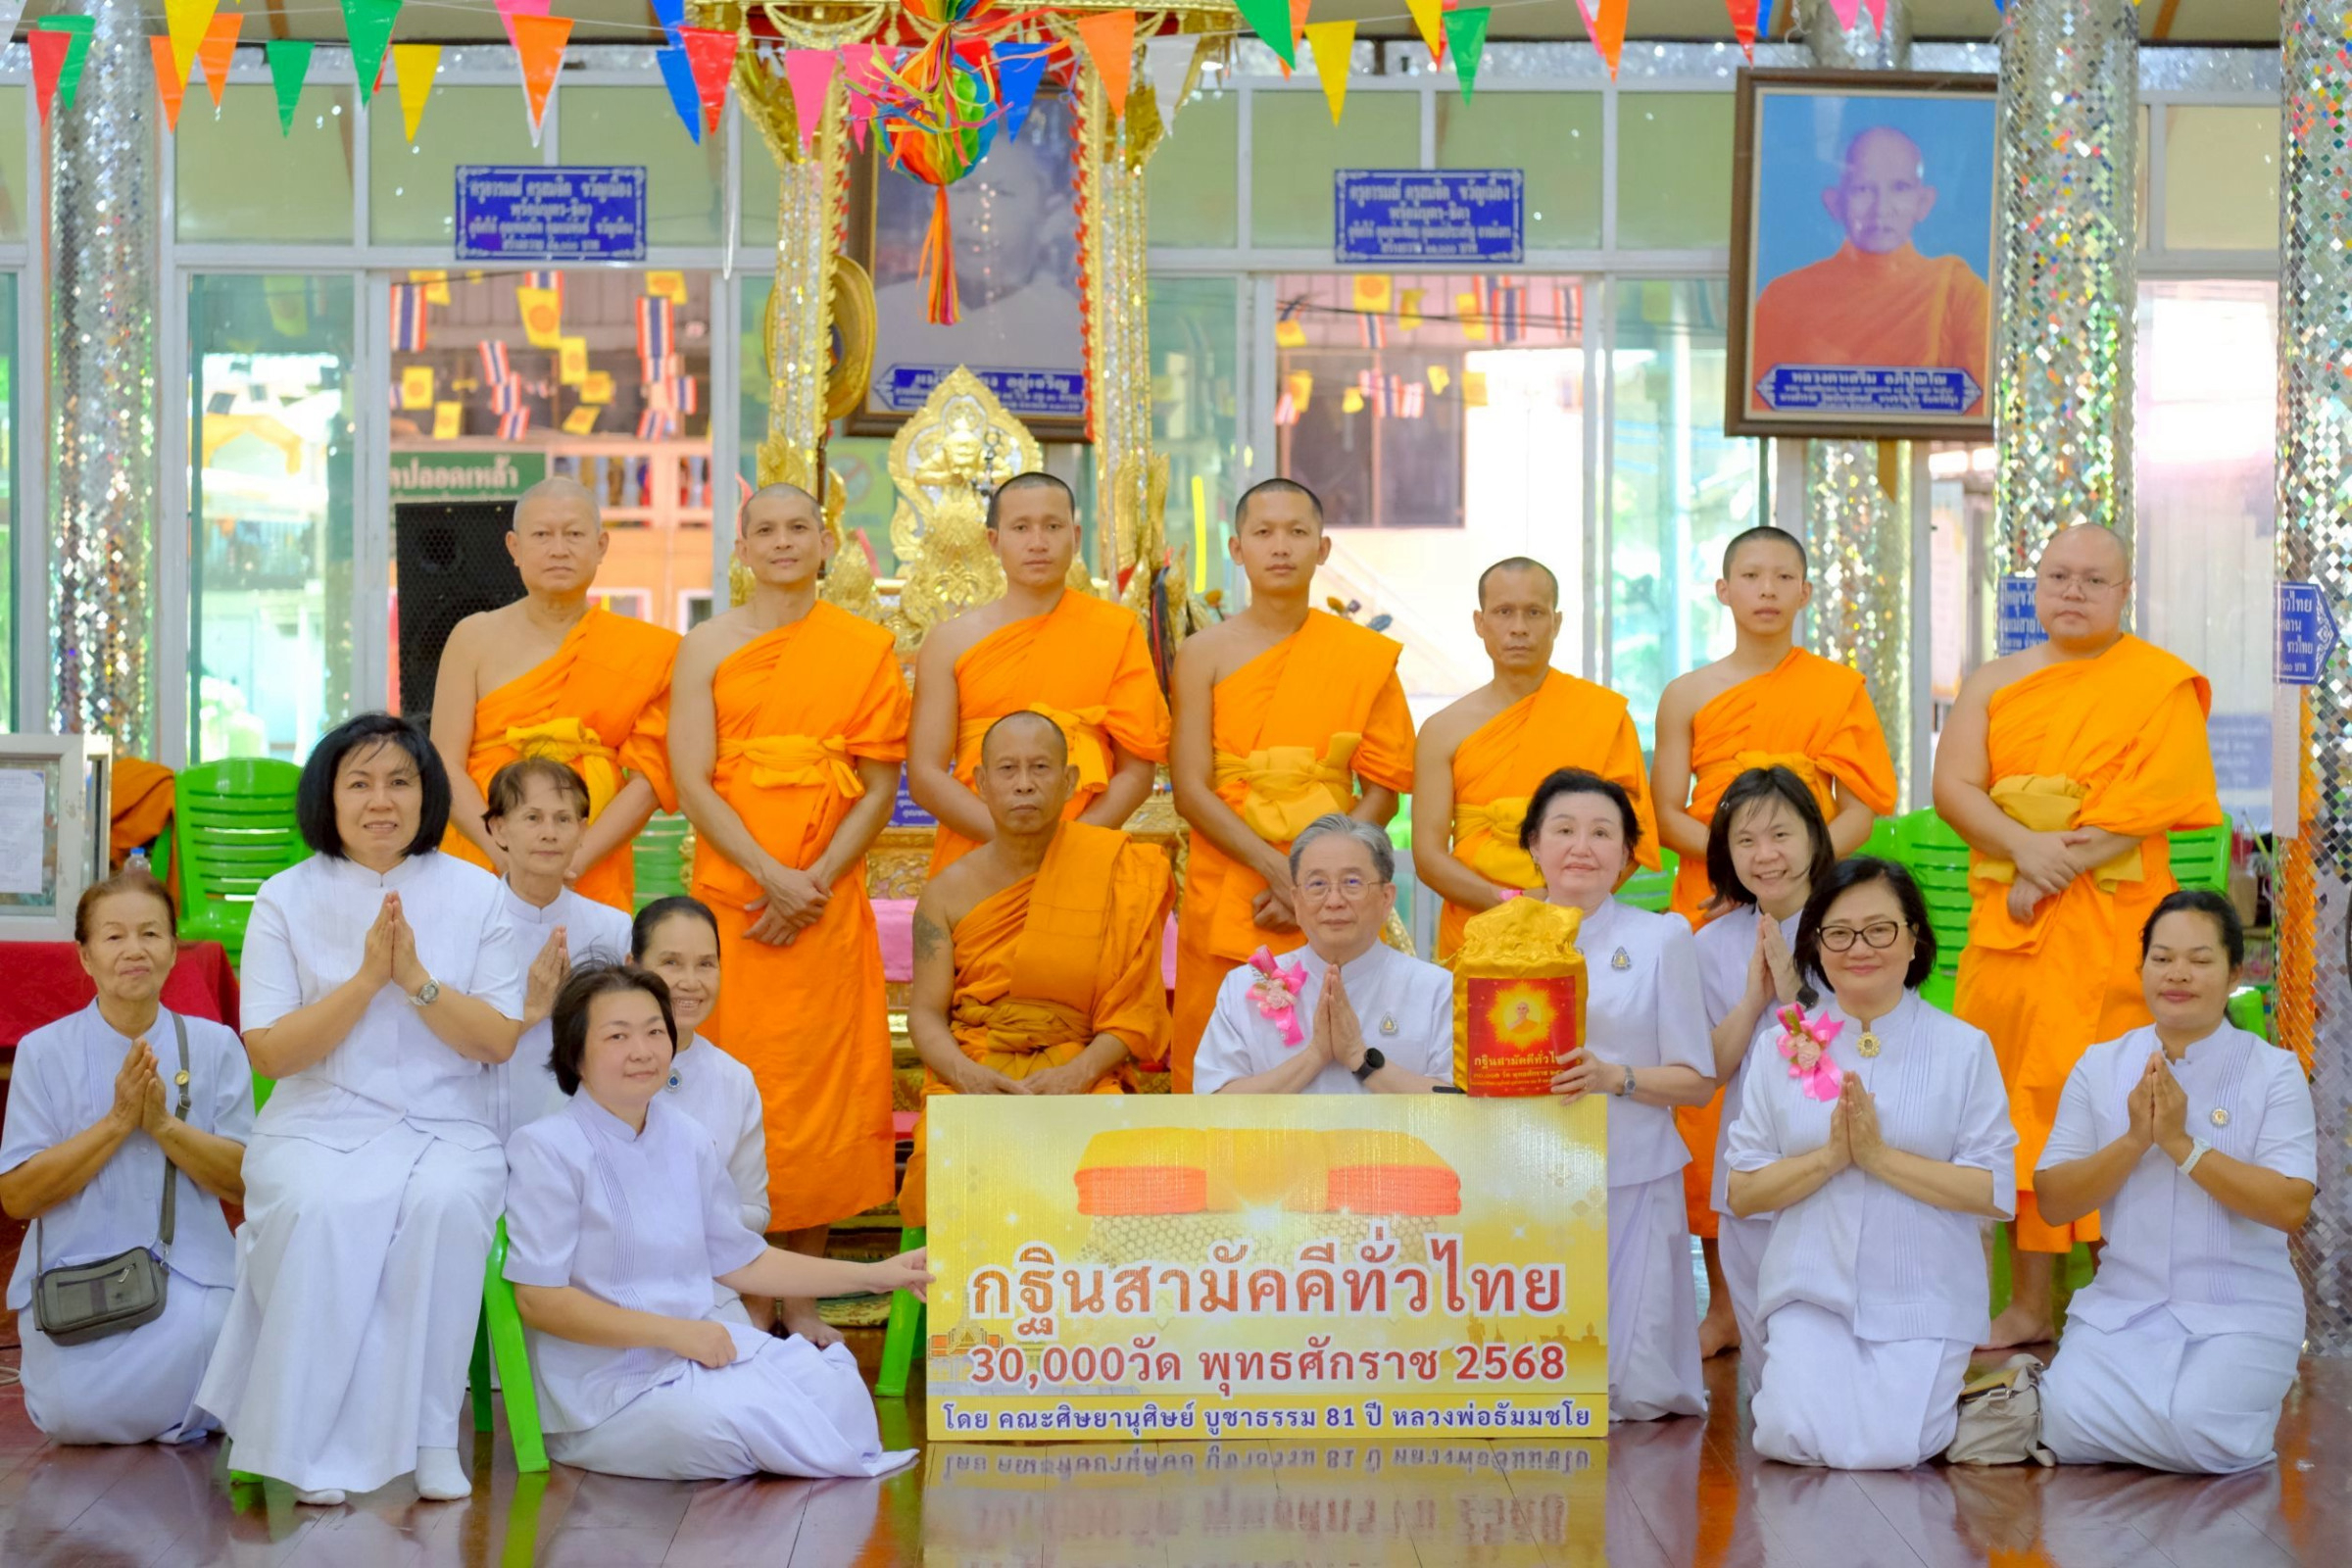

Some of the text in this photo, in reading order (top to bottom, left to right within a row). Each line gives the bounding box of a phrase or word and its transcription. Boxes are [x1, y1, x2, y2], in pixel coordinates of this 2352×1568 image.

[973, 1226, 1560, 1335] กฐินสามัคคีทั่วไทย
[971, 1336, 1565, 1396] 30,000วัด พุทธศักราช 2568
[943, 1400, 1591, 1436] โดย คณะศิษยานุศิษย์ บูชาธรรม 81 ปี หลวงพ่อธัมมชโย
